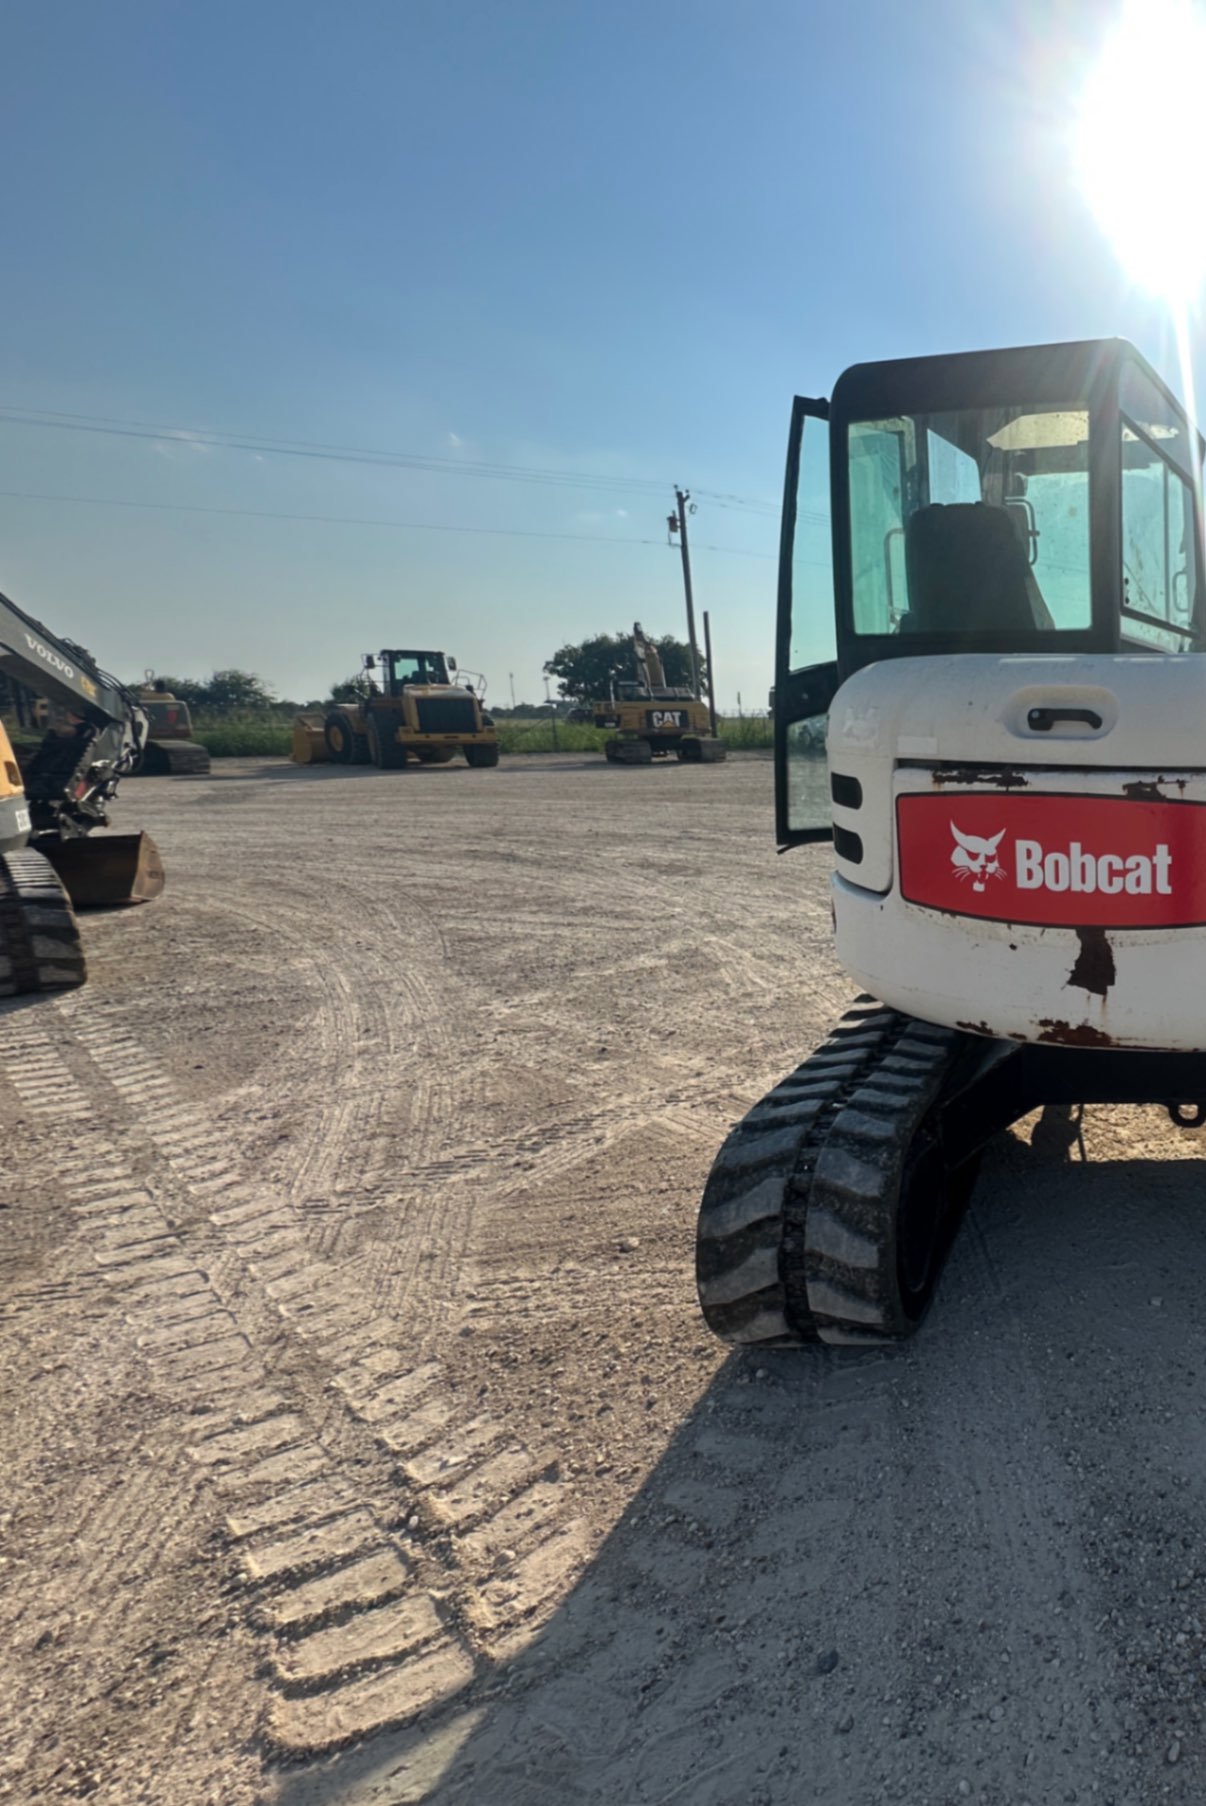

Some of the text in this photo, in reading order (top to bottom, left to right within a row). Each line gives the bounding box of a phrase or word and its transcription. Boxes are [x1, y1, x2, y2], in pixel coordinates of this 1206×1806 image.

[24, 632, 75, 679] VOLVO
[652, 711, 681, 728] CAT
[1015, 839, 1172, 895] Bobcat
